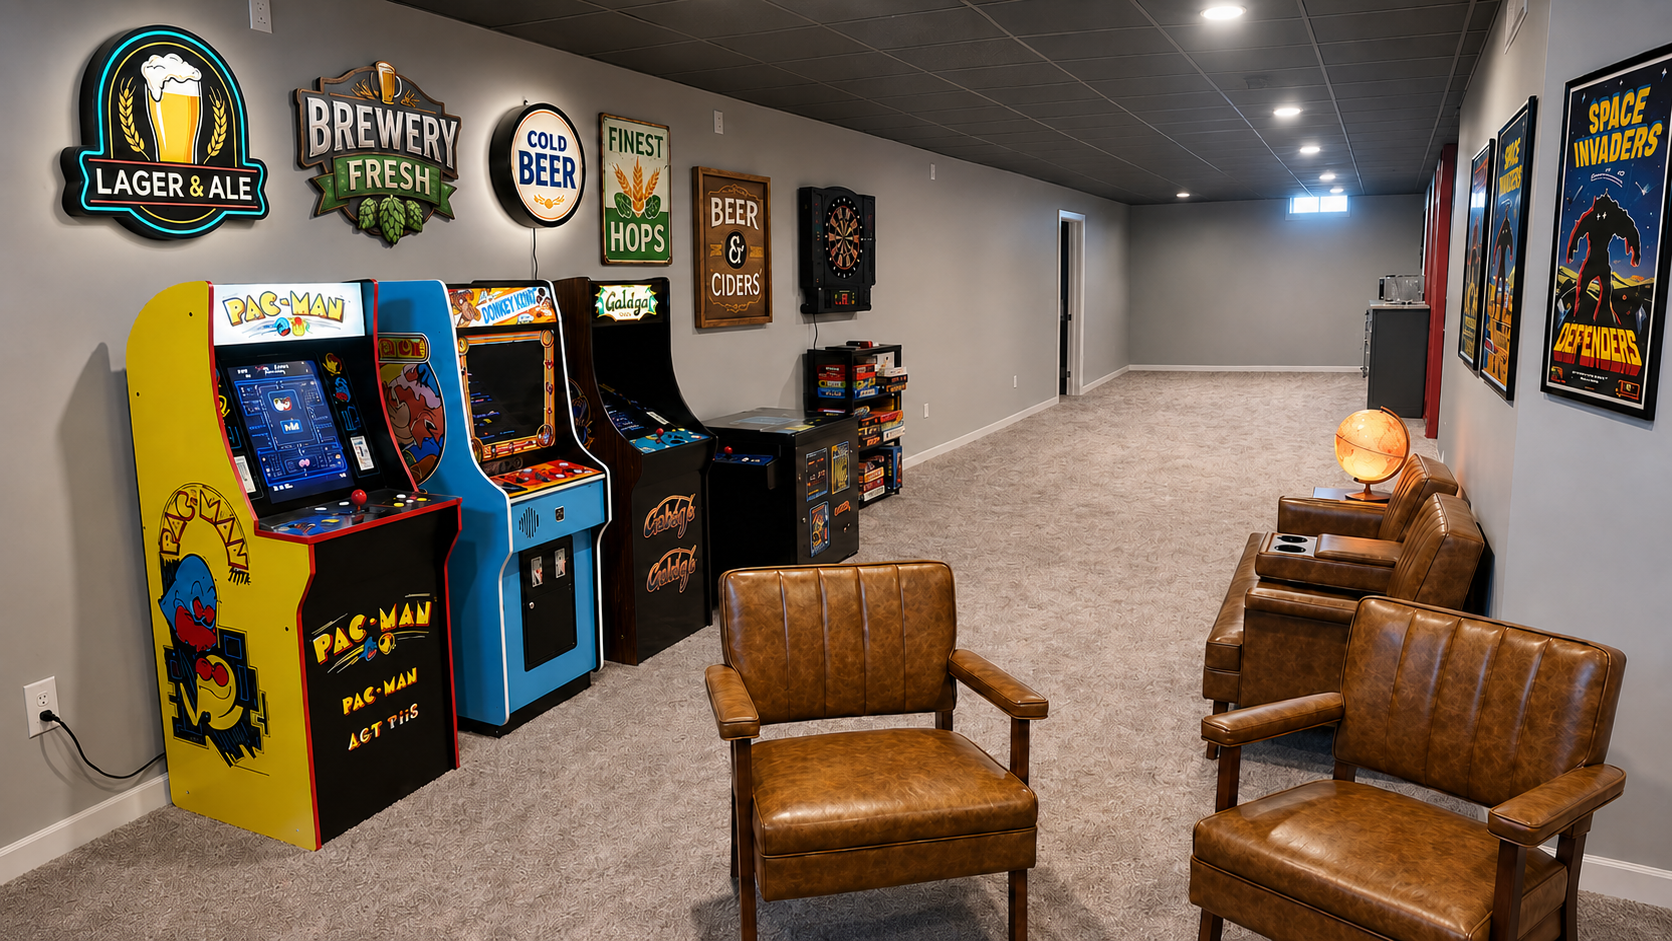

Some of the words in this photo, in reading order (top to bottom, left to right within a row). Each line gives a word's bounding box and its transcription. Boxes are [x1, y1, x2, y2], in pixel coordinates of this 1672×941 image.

[1589, 85, 1651, 134] SPACE
[307, 97, 459, 169] BREWERY
[527, 129, 568, 152] COLD
[608, 127, 664, 158] FINEST
[1574, 122, 1662, 168] INVADERS
[96, 167, 184, 199] LAGER
[189, 176, 204, 198] &
[208, 175, 252, 201] ALE
[347, 159, 431, 195] FRESH
[519, 150, 577, 190] BEER
[711, 197, 758, 230] BEER
[610, 221, 665, 253] HOPS
[728, 236, 745, 264] &
[711, 272, 760, 297] CIDERS
[222, 291, 345, 326] PAC-MAN
[1553, 322, 1642, 376] DEFENDERS
